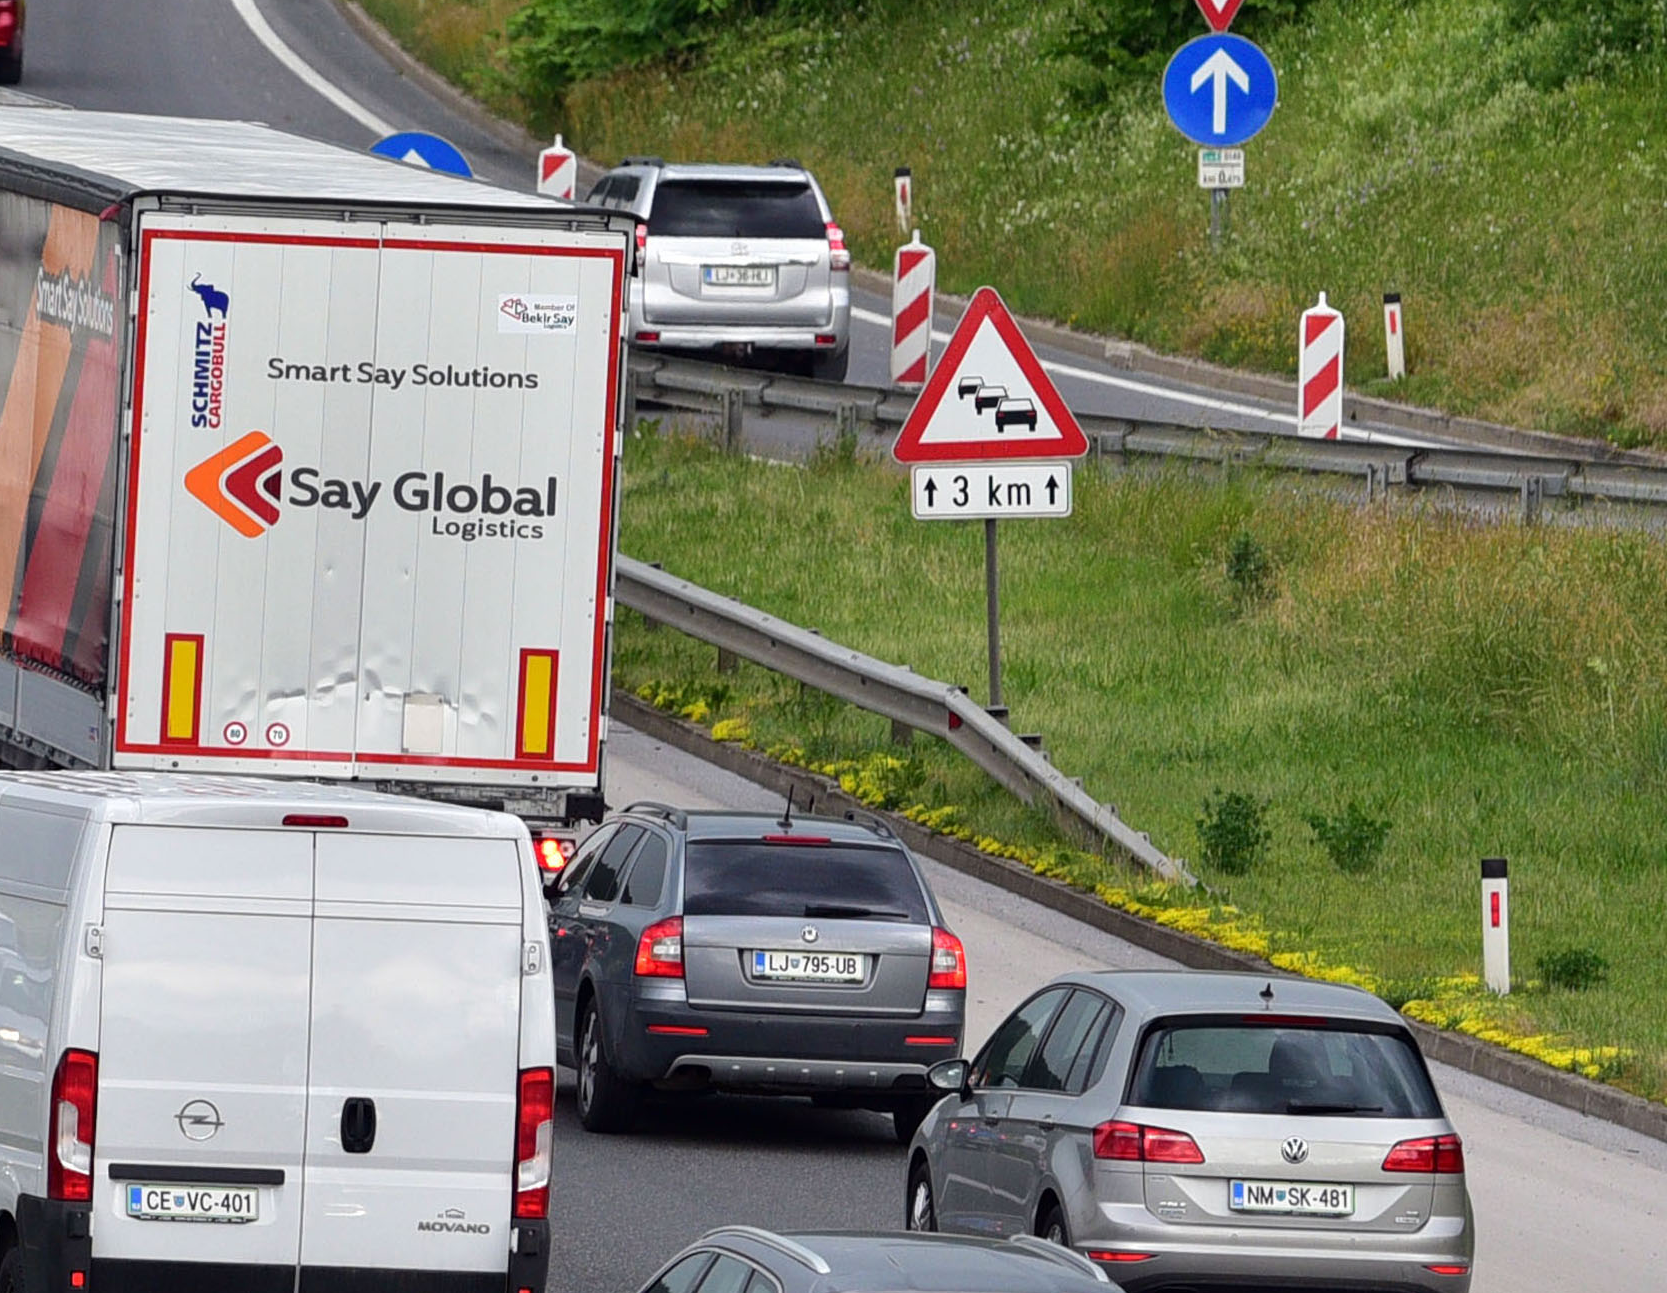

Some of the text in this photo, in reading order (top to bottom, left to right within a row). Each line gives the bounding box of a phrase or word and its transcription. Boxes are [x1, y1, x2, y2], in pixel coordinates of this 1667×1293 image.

[553, 313, 574, 326] Say
[192, 321, 212, 429] SCHMITZ
[208, 323, 226, 429] CARGOBULL
[267, 358, 539, 390] Smart Say Solutions
[289, 467, 557, 519] Say Global
[953, 475, 1031, 507] 3 km
[432, 516, 544, 541] Logistics
[770, 955, 857, 974] LJ 795-UB
[146, 1191, 252, 1214] CE VC-401
[1247, 1186, 1348, 1207] NM SK-481
[418, 1221, 490, 1235] MOVANO
